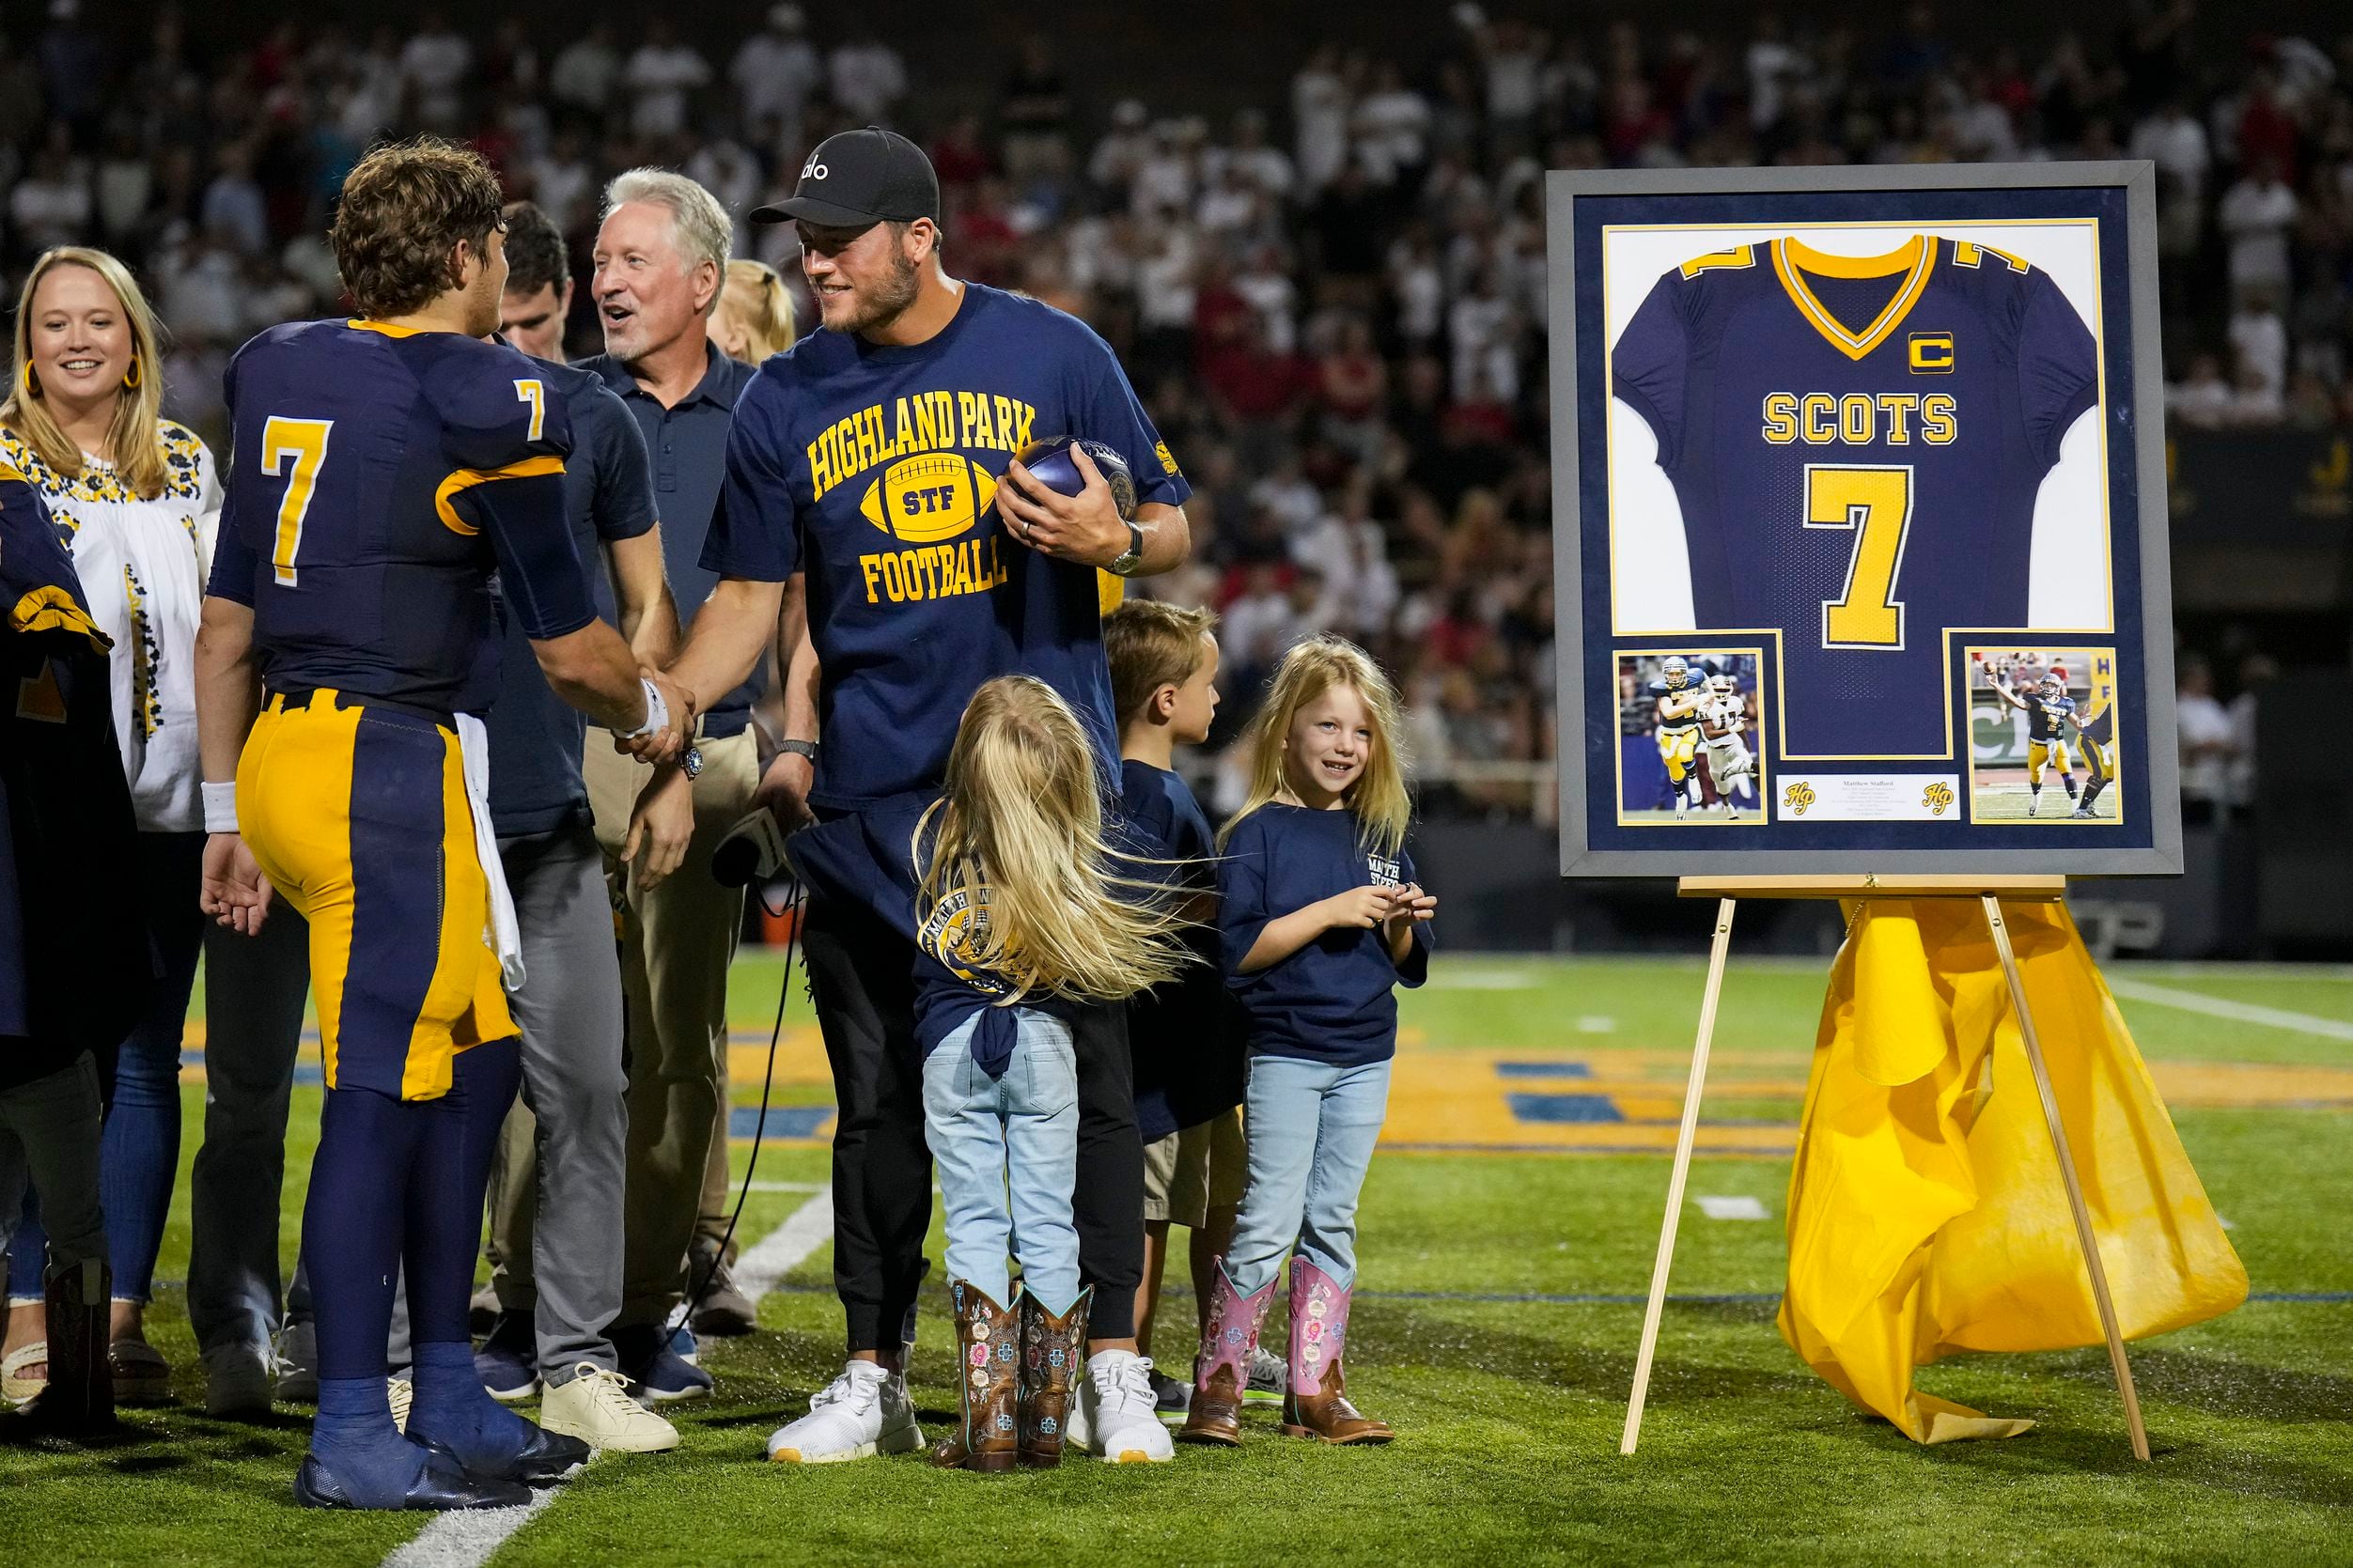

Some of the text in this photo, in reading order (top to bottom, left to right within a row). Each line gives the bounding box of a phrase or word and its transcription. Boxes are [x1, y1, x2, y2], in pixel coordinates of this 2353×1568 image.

[801, 154, 829, 180] alo
[1910, 339, 1953, 367] C
[513, 379, 545, 442] 7
[1762, 392, 1957, 446] SCOTS
[807, 391, 1036, 503] HIGHLAND PARK
[260, 415, 335, 587] 7
[902, 485, 955, 516] STF
[859, 535, 1008, 603] FOOTBALL
[1802, 463, 1914, 651] 7
